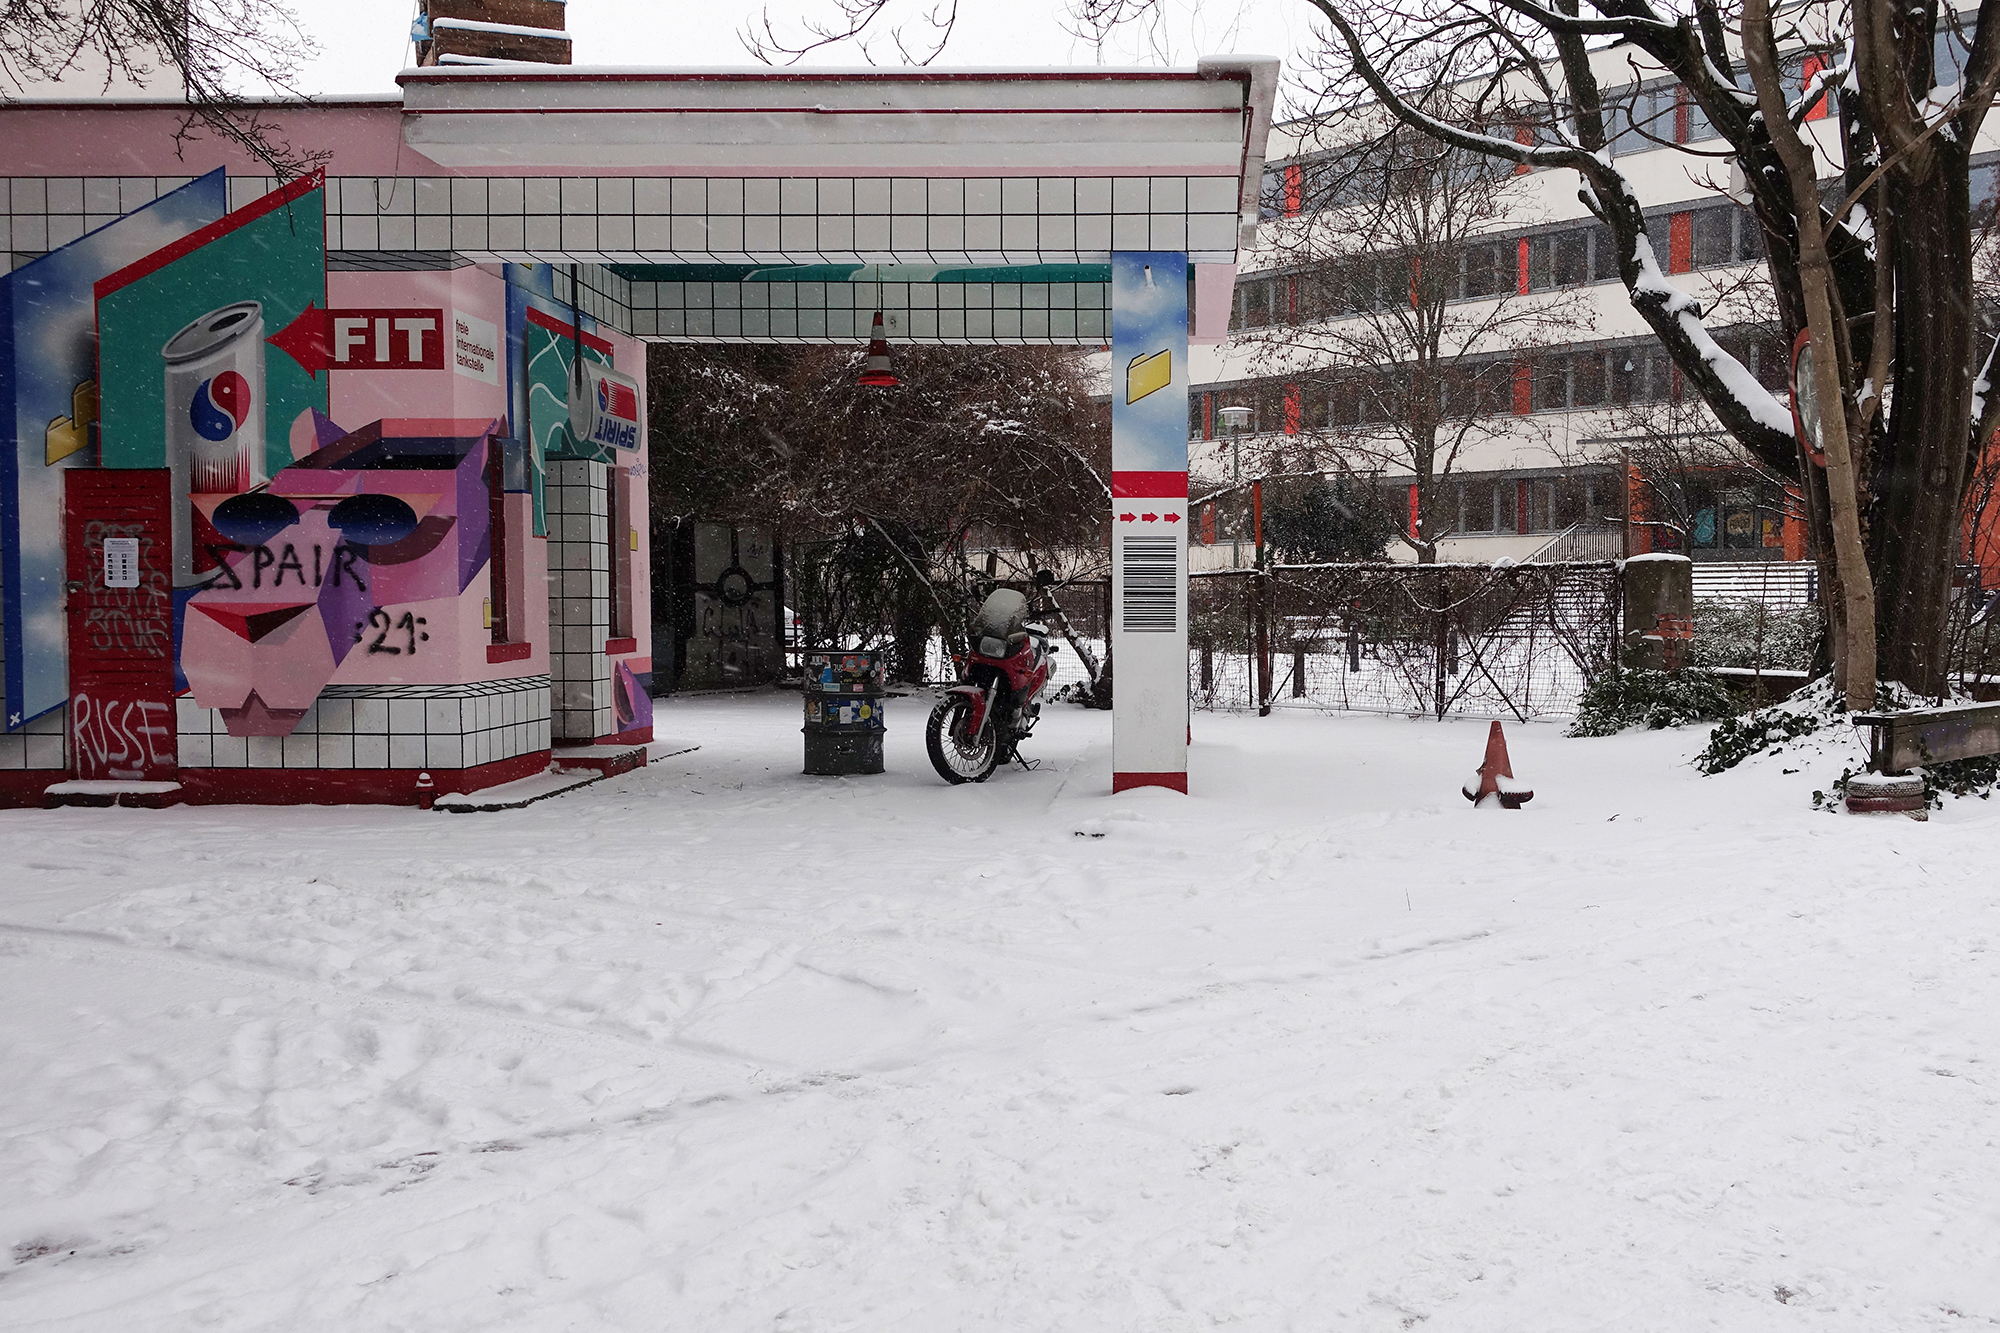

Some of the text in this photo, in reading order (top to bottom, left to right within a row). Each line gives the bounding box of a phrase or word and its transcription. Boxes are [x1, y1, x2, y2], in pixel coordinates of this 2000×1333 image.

[334, 317, 436, 362] FIT
[455, 319, 469, 336] freie
[456, 335, 495, 361] internationale
[456, 352, 485, 373] tankstelle
[594, 416, 637, 450] SPIRIT
[74, 693, 176, 780] RUSSE
